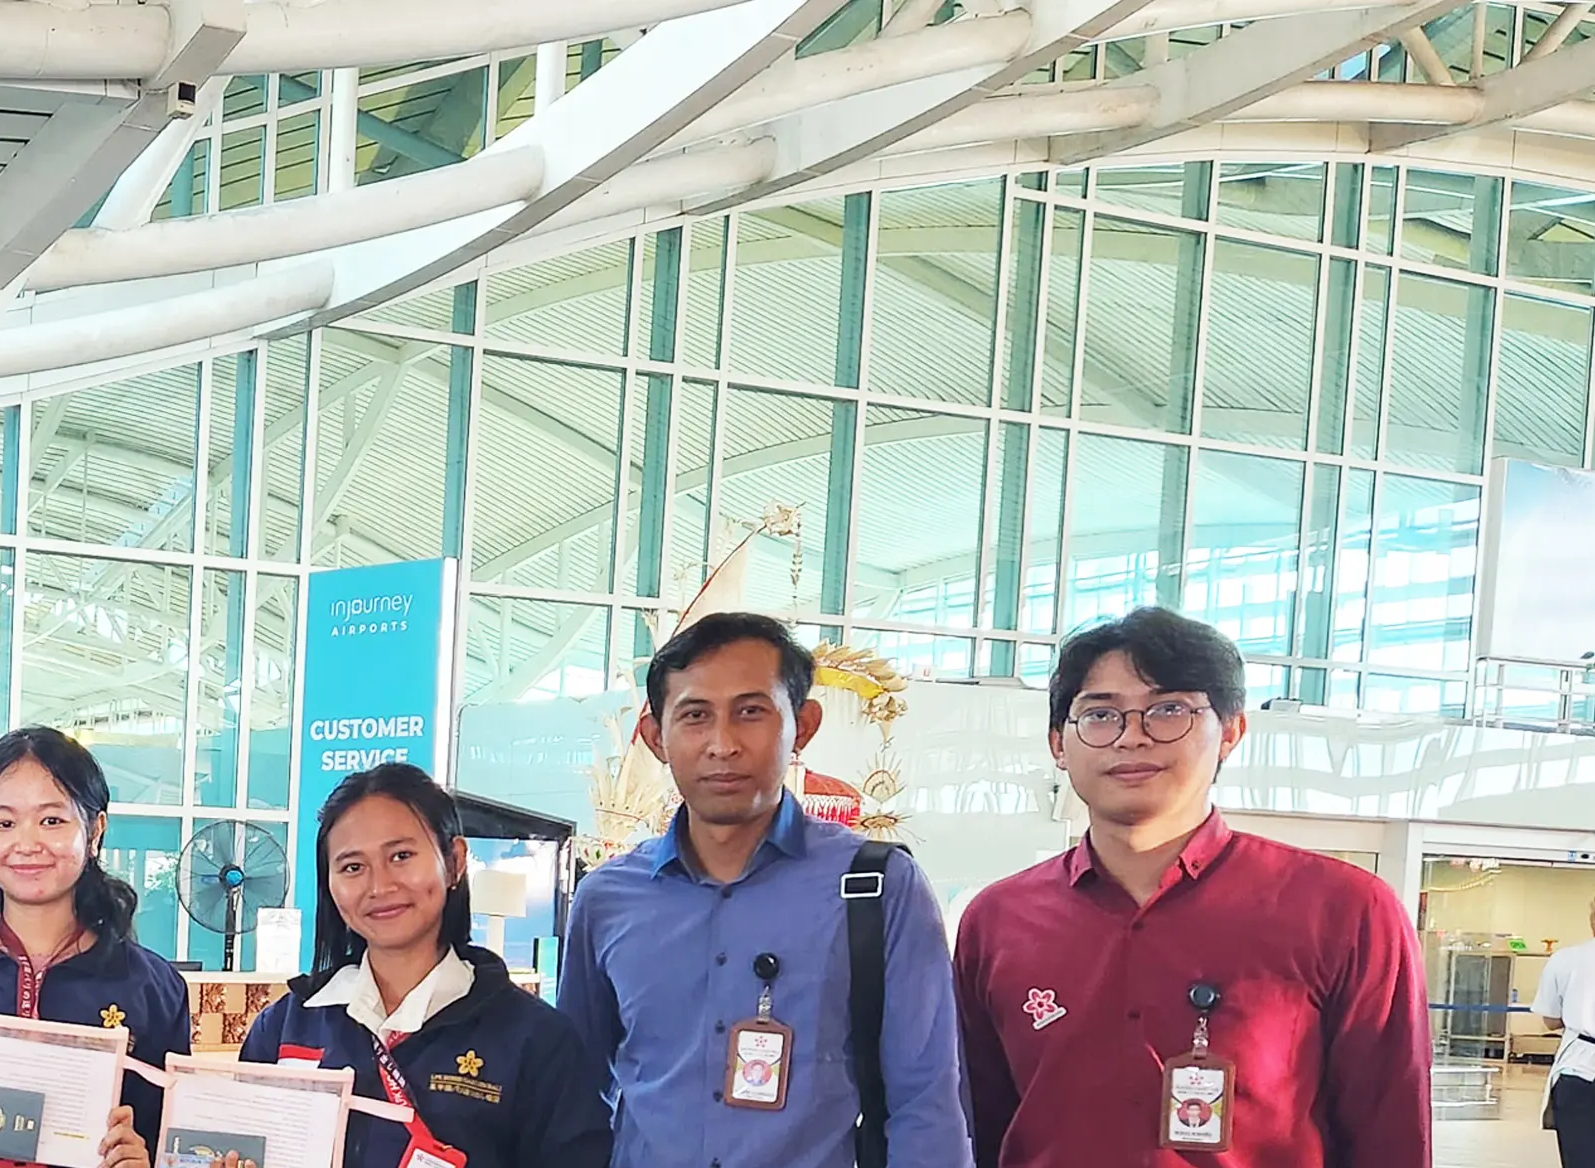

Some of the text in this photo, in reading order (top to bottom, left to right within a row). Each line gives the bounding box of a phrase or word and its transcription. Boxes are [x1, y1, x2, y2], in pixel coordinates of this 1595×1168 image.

[330, 593, 413, 622] injourney
[331, 620, 408, 637] AIRPORTS
[310, 716, 423, 741] CUSTOMER
